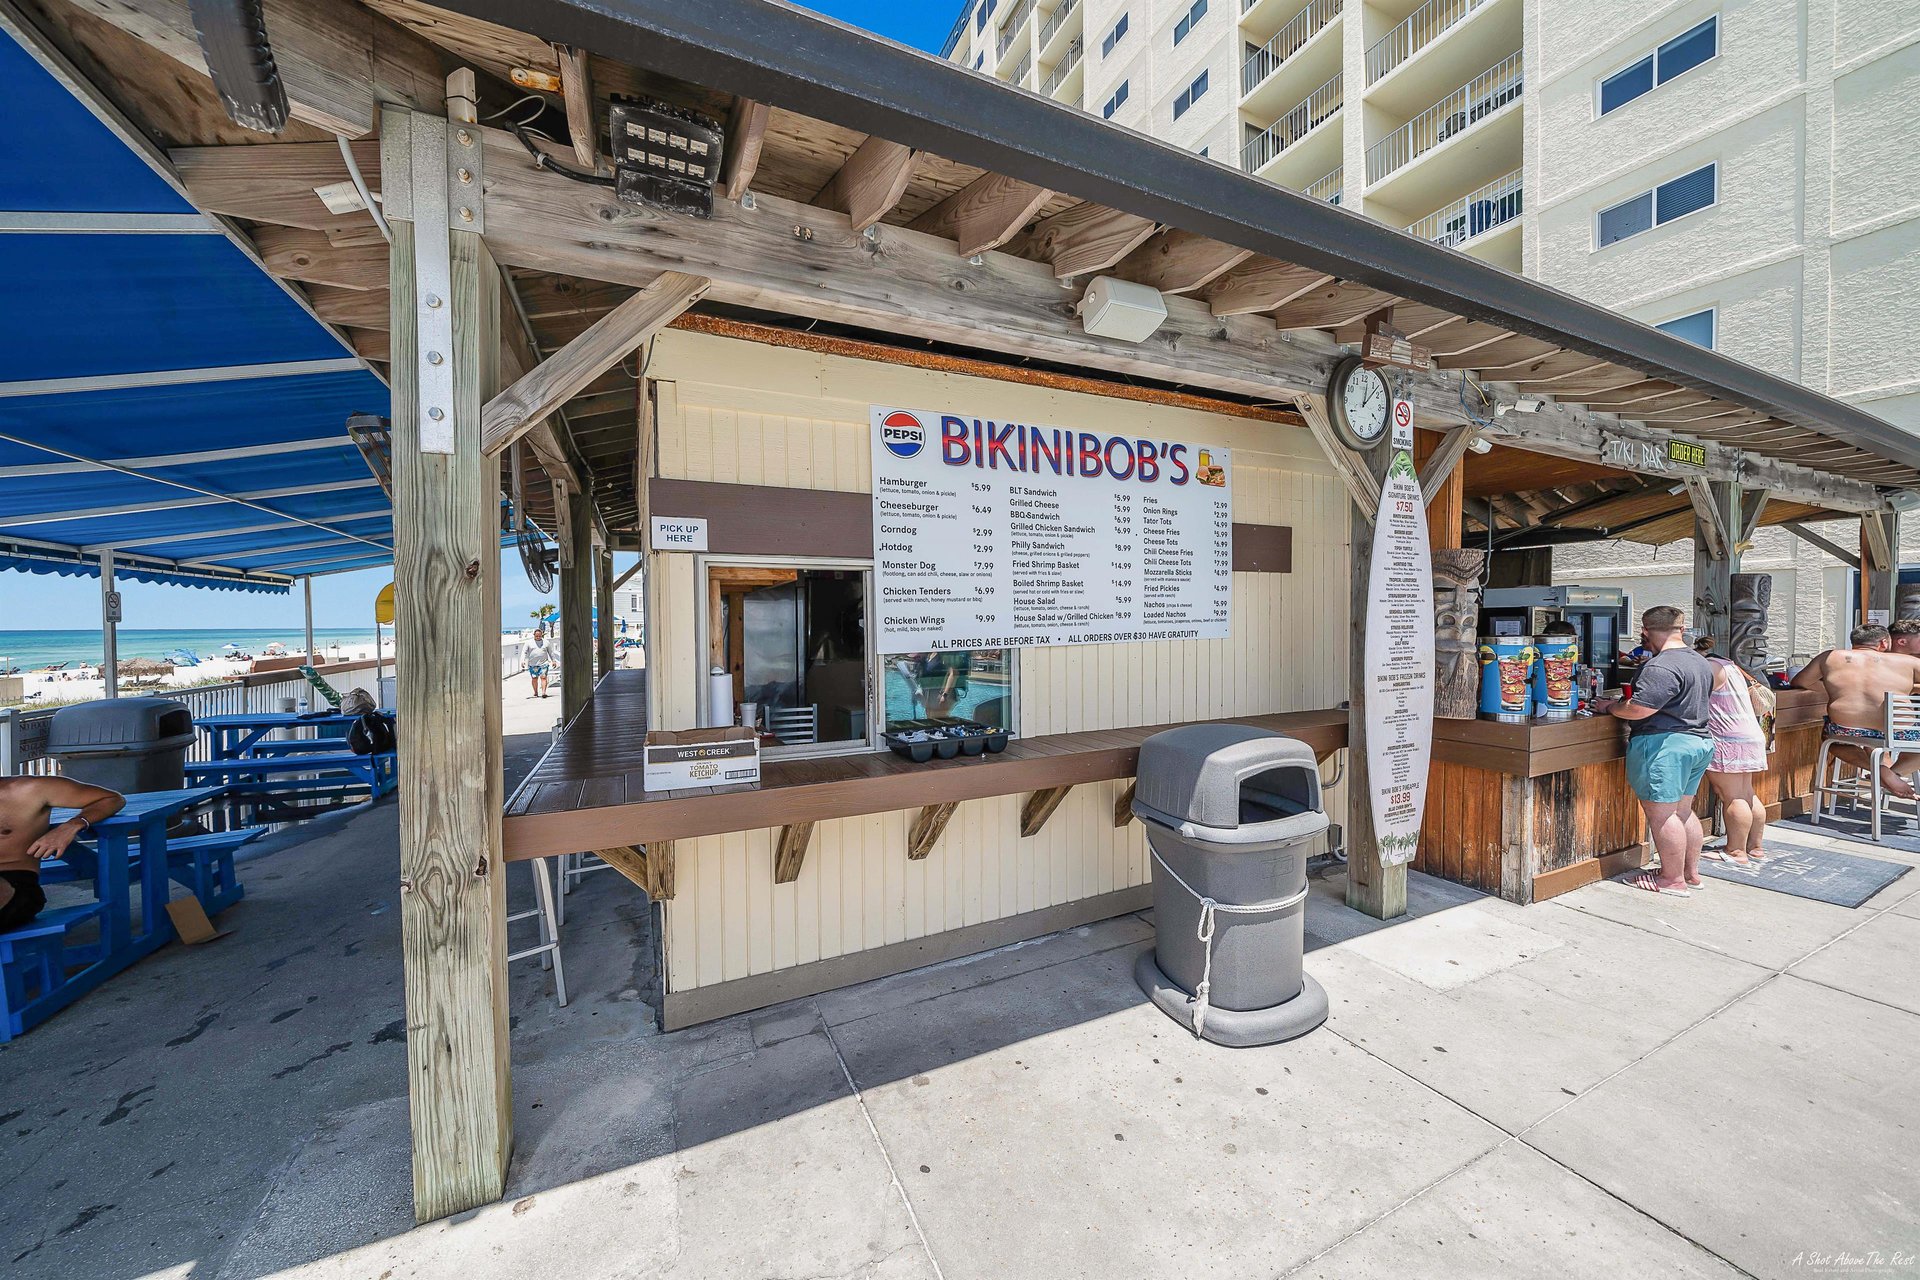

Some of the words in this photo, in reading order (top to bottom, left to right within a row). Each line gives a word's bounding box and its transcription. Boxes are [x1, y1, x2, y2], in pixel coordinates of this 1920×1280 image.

[1353, 377, 1358, 385] 11
[884, 428, 922, 441] PEPSI
[1393, 437, 1411, 447] SMOKING
[941, 416, 1190, 486] BIKINIBOB'S
[1610, 441, 1634, 463] TIKI
[1642, 443, 1667, 471] BAR
[1671, 443, 1690, 461] ORDER
[1691, 447, 1704, 465] HERE
[880, 477, 927, 488] Hamburger
[972, 482, 991, 492] $5.99
[1024, 488, 1057, 497] Sandwich
[880, 501, 939, 512] Cheeseburger
[972, 505, 992, 514] $6.49
[1010, 499, 1032, 507] Grilled
[1034, 501, 1059, 509] Cheese
[1396, 501, 1413, 512] $7.50
[1026, 512, 1060, 520] Sandwich
[1162, 508, 1178, 516] Rings
[660, 524, 683, 533] PICK
[685, 525, 699, 534] UP
[881, 525, 917, 535] Corndog
[973, 528, 992, 536] $2.99
[1011, 522, 1033, 531] Grilled
[1035, 524, 1062, 532] Chicken
[1064, 525, 1096, 534] Sandwich
[666, 534, 693, 542] HERE
[881, 543, 913, 553] Hotdog
[973, 544, 993, 553] $2.99
[1012, 541, 1031, 550] Philly
[1032, 542, 1065, 550] Sandwich
[882, 561, 917, 569] Monster
[920, 561, 936, 571] Dog
[974, 561, 994, 570] $7.99
[1031, 561, 1056, 569] Shrimp
[1036, 580, 1060, 588] Shrimp
[883, 587, 917, 595] Chicken
[919, 587, 951, 595] Tenders
[975, 586, 995, 595] $6.99
[884, 616, 918, 625] Chicken
[920, 616, 945, 625] Wings
[976, 614, 995, 622] $9.99
[1057, 613, 1087, 622] w/Grilled
[1084, 633, 1112, 642] ORDERS
[1167, 630, 1199, 638] GRATUITY
[931, 640, 948, 649] ALL
[951, 639, 982, 648] PRICES
[985, 638, 1001, 646] ARE
[1004, 636, 1034, 646] BEFORE
[1036, 636, 1050, 644] TAX
[689, 769, 718, 778] KETCHUP
[1391, 792, 1411, 805] $13.99
